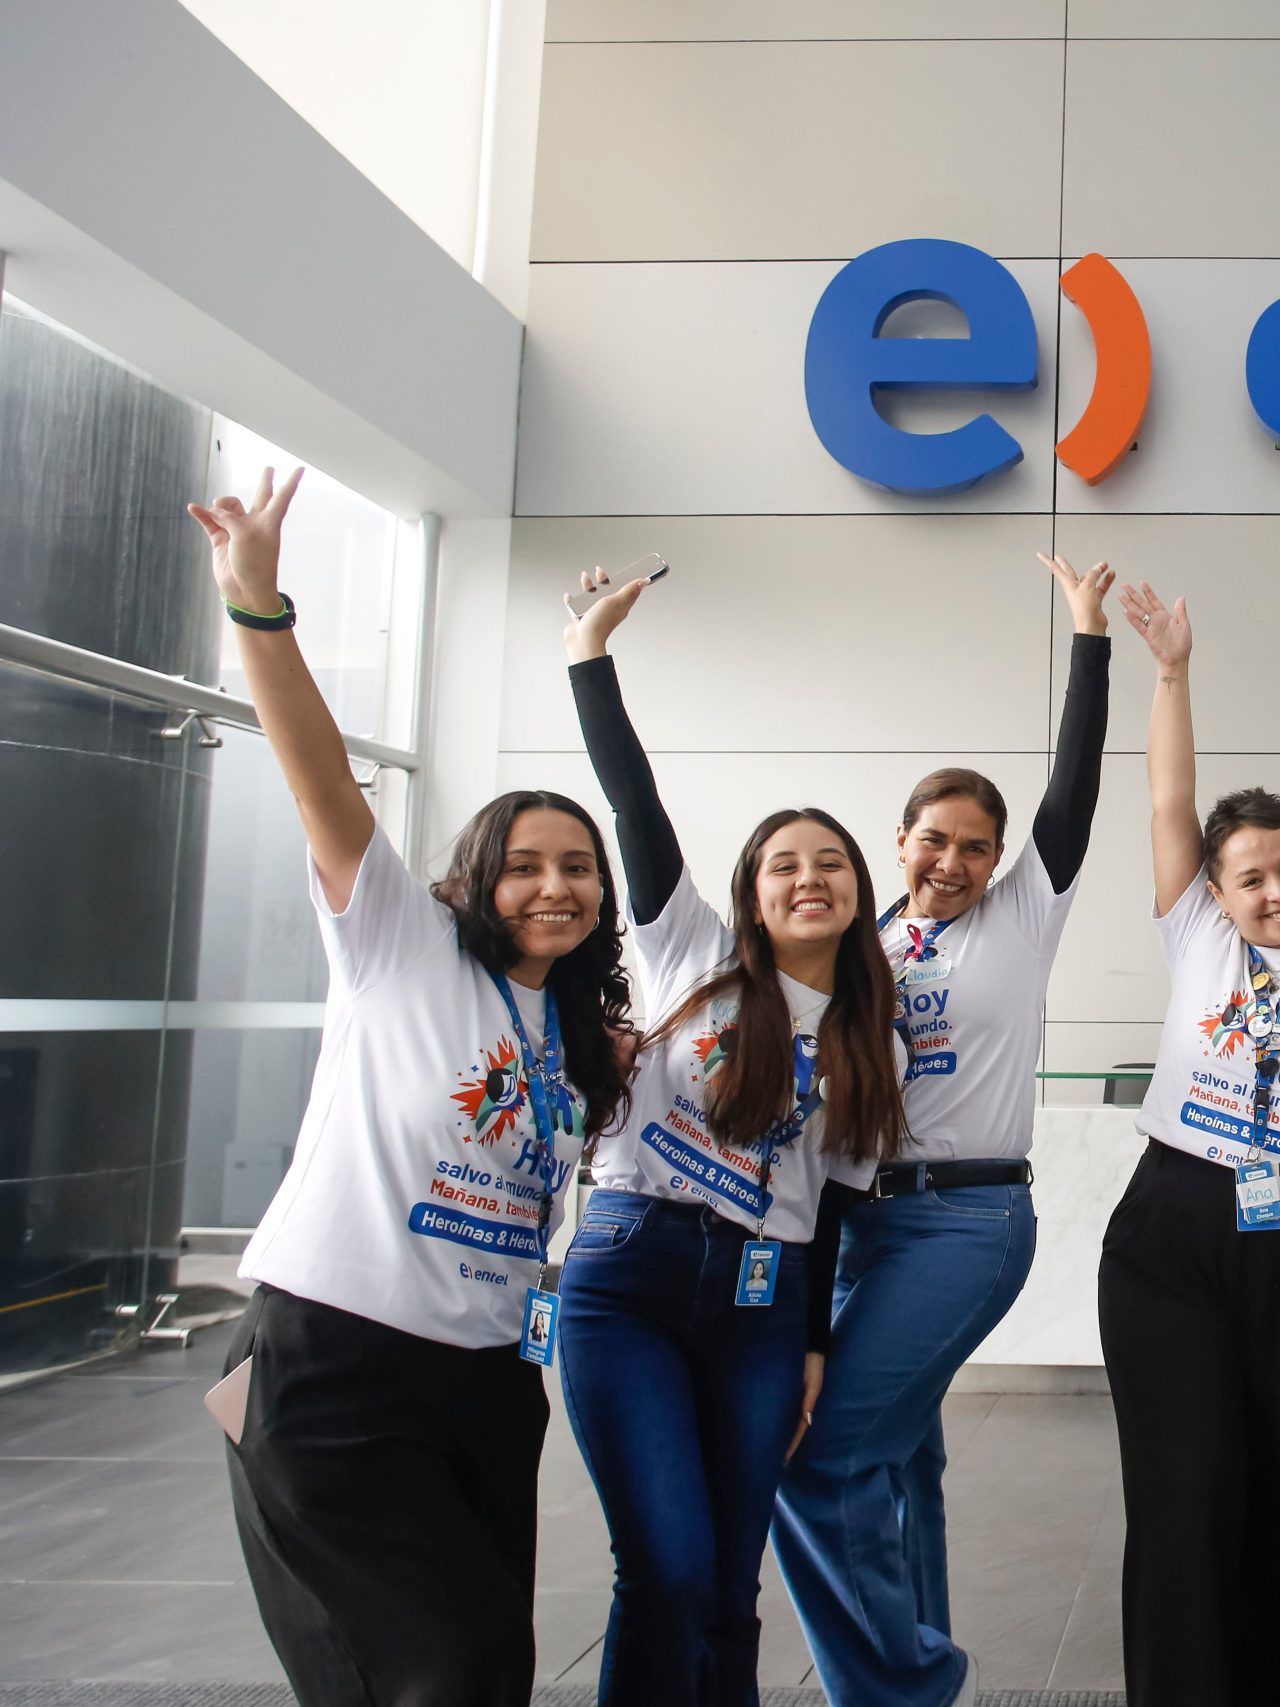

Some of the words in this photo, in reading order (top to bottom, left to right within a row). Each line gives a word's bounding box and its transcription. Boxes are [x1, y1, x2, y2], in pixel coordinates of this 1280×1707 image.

[911, 1018, 952, 1035] undo.
[912, 1036, 952, 1050] mbién.
[1192, 1070, 1229, 1090] salvo
[1232, 1083, 1248, 1096] al
[1189, 1085, 1241, 1112] Mañana,
[665, 1109, 713, 1151] Mañana,
[1186, 1107, 1239, 1135] Heroínas
[1240, 1125, 1251, 1139] &
[651, 1131, 703, 1175] Heroínas
[705, 1167, 716, 1183] &
[718, 1173, 760, 1208] Héroes
[1225, 1152, 1244, 1165] ent
[436, 1160, 492, 1186] salvo
[430, 1178, 500, 1214] Mañana,
[506, 1200, 540, 1222] tambié
[1247, 1188, 1274, 1204] Ana
[421, 1210, 494, 1243] Heroínas
[497, 1230, 506, 1246] &
[508, 1232, 537, 1252] Héro
[474, 1269, 508, 1286] entel
